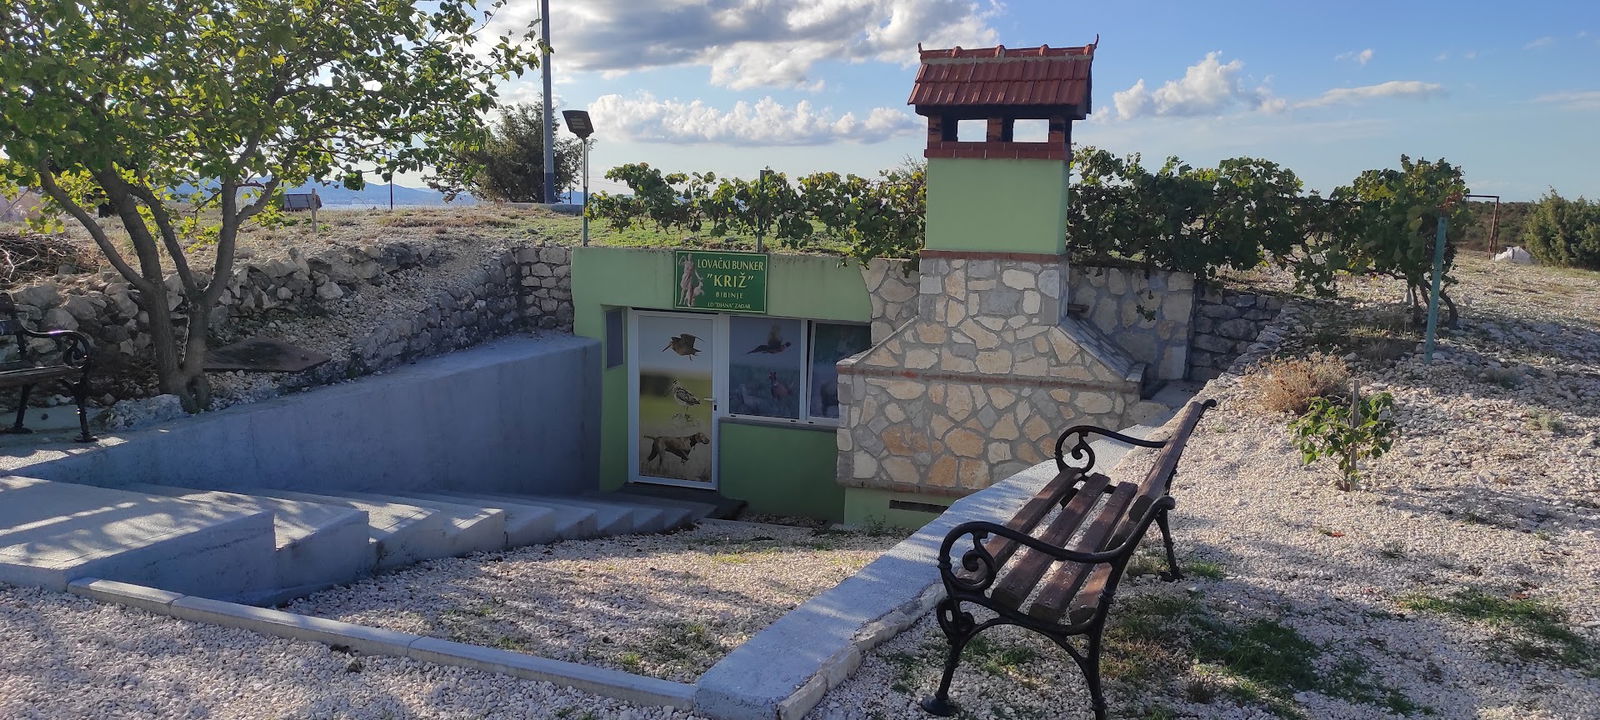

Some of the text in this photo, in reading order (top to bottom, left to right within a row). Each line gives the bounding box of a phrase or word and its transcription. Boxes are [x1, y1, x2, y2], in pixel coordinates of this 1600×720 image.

[697, 257, 764, 271] LOVAČKI BUNKER
[707, 272, 754, 288] "KRIŽ"
